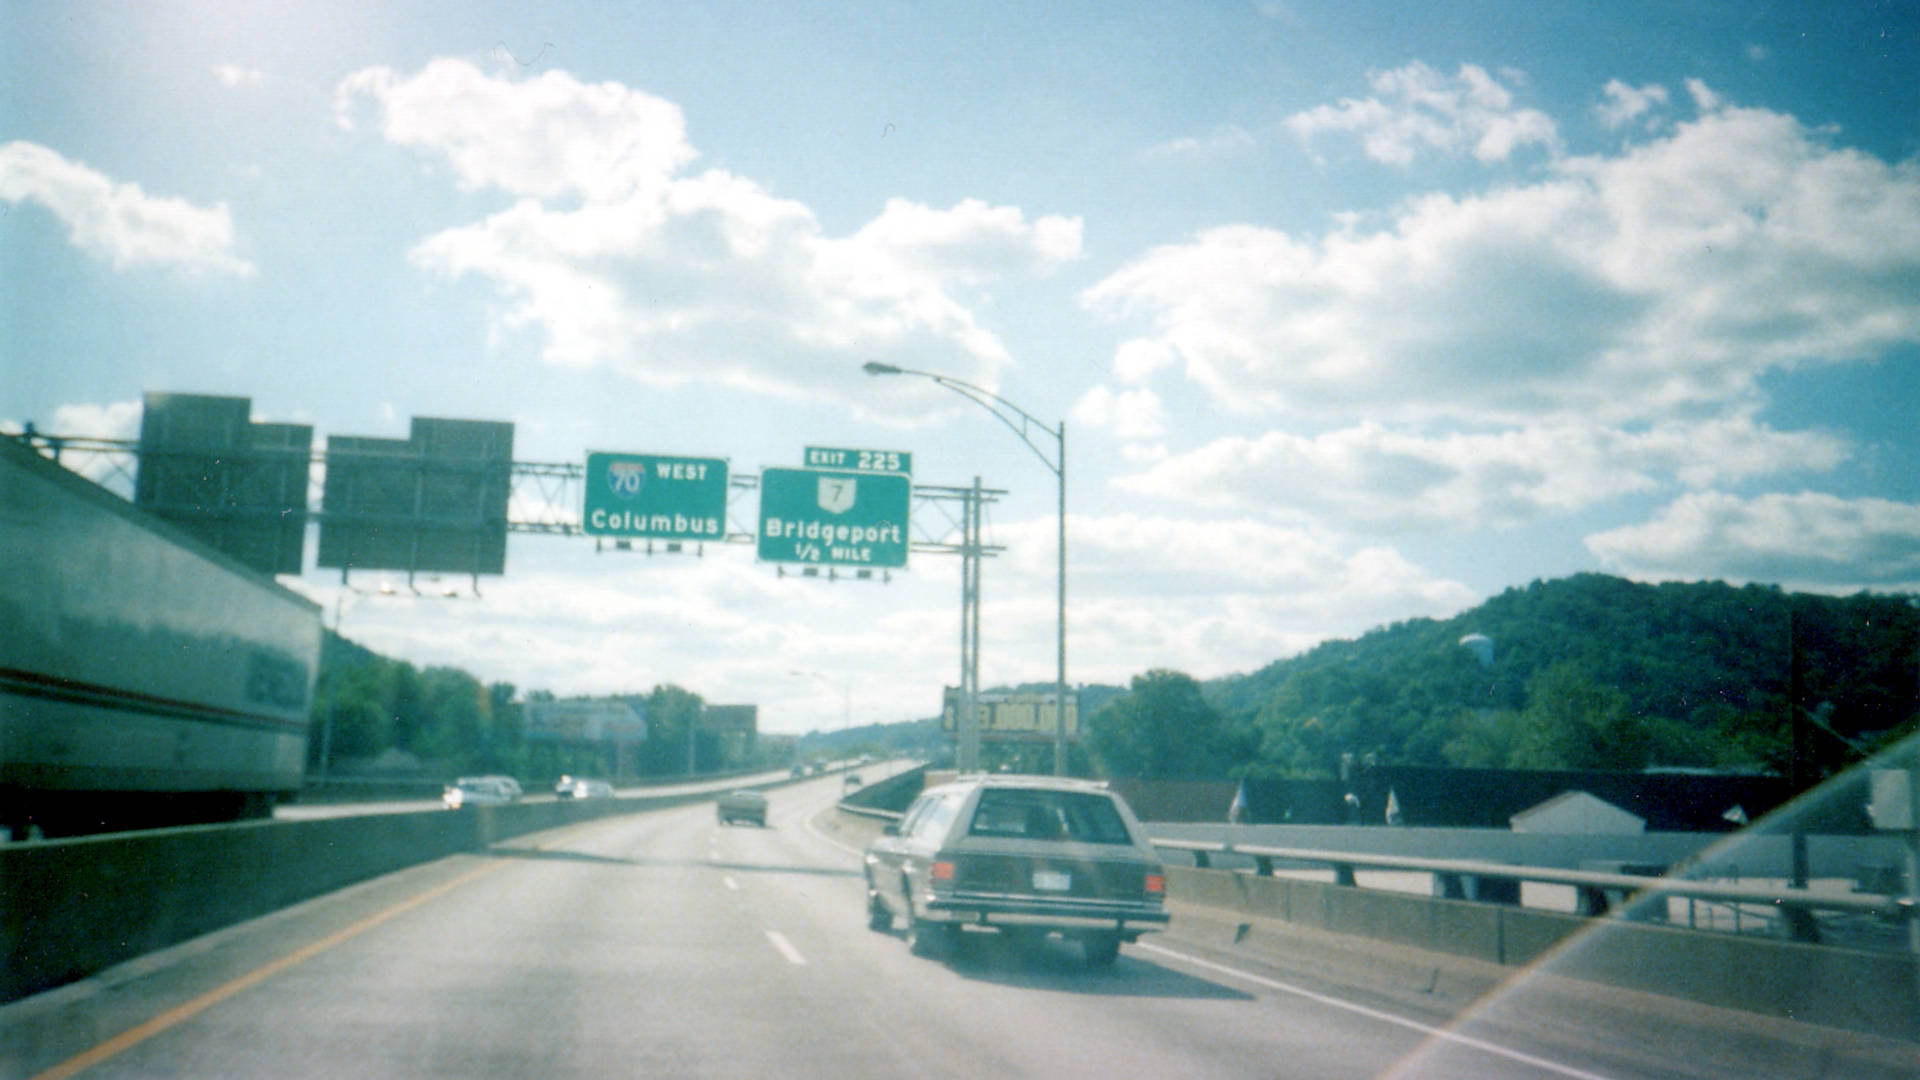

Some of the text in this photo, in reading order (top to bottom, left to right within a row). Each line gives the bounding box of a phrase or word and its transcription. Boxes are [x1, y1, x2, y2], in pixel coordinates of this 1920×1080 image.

[809, 450, 901, 471] EXIT 225
[611, 463, 708, 493] 70 WEST
[830, 484, 844, 502] 7
[591, 508, 719, 535] Columbus
[766, 517, 901, 547] Bridgeport
[831, 546, 871, 562] MILE
